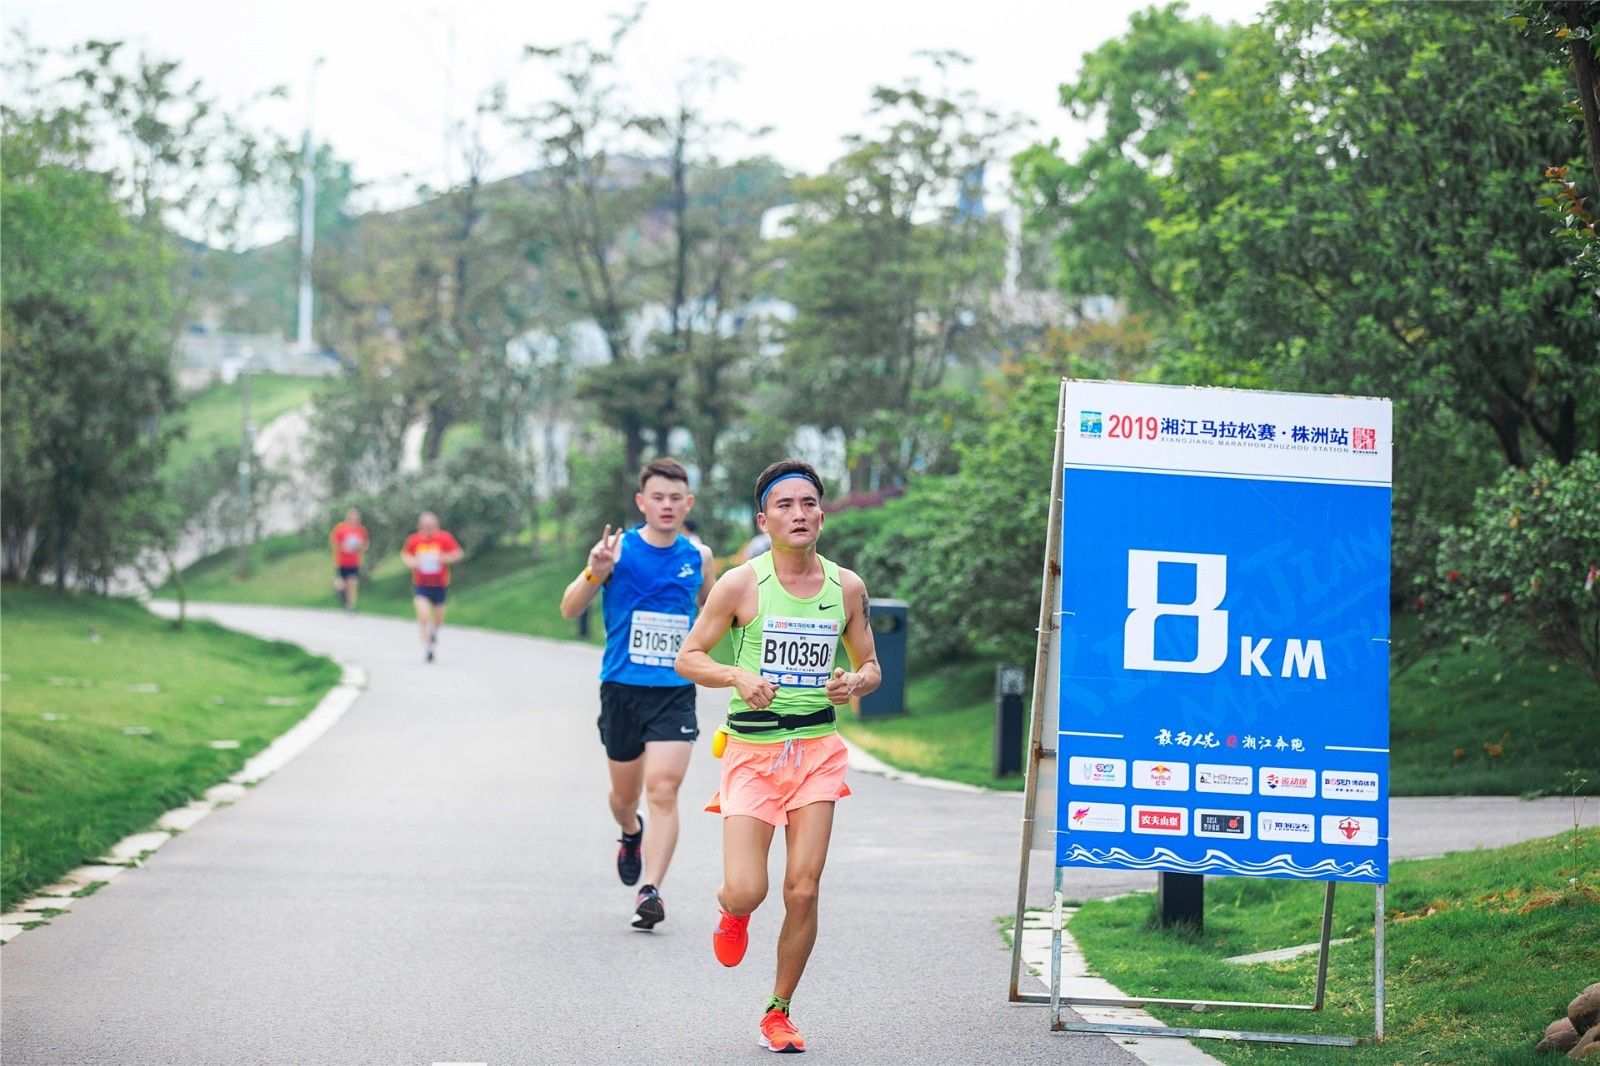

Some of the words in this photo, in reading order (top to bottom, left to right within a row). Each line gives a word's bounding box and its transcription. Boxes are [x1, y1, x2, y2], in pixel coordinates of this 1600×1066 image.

[1108, 414, 1158, 440] 2019
[1160, 417, 1349, 446] 湘江马拉松赛·株洲站
[1218, 440, 1266, 449] MARATHON
[1313, 446, 1349, 454] STATION
[1124, 549, 1229, 674] 8
[1240, 636, 1327, 680] KM
[764, 638, 829, 668] B10350
[1242, 735, 1305, 752] 湘江奔跑
